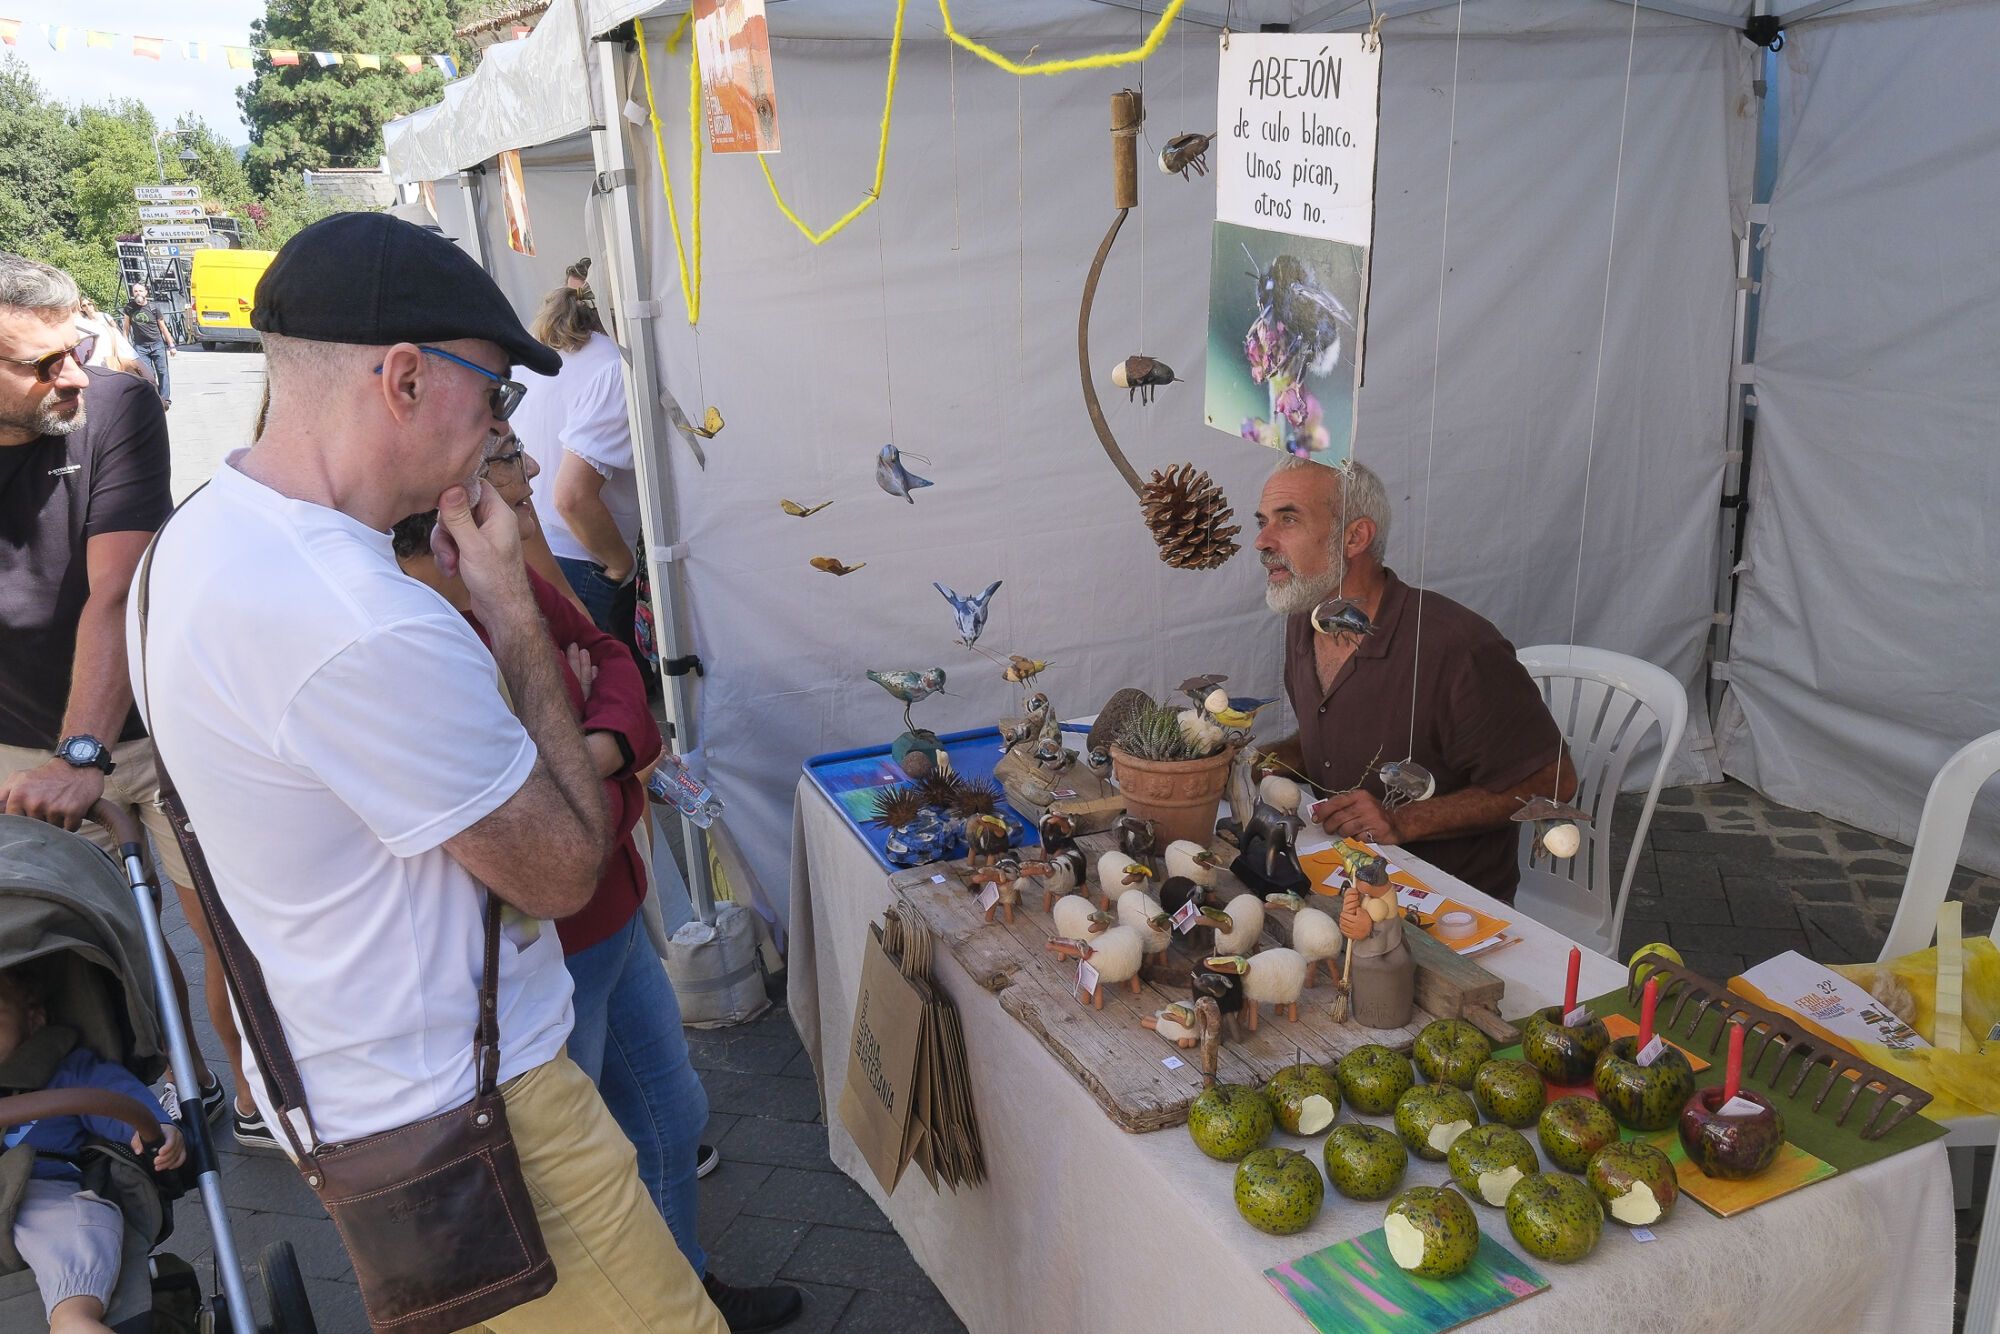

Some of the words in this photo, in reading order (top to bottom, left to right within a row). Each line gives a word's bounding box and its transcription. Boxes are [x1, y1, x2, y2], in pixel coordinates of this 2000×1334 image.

[1249, 46, 1342, 100] ABEJÓN
[1233, 107, 1250, 140] de
[1261, 110, 1290, 143] culo
[1302, 111, 1356, 148] blanco.
[1246, 152, 1282, 181] Unos
[1292, 158, 1339, 194] pican,
[1254, 192, 1292, 220] otros
[1303, 202, 1326, 224] no.
[1794, 992, 1823, 1010] FERIA
[863, 1023, 880, 1062] FERIA
